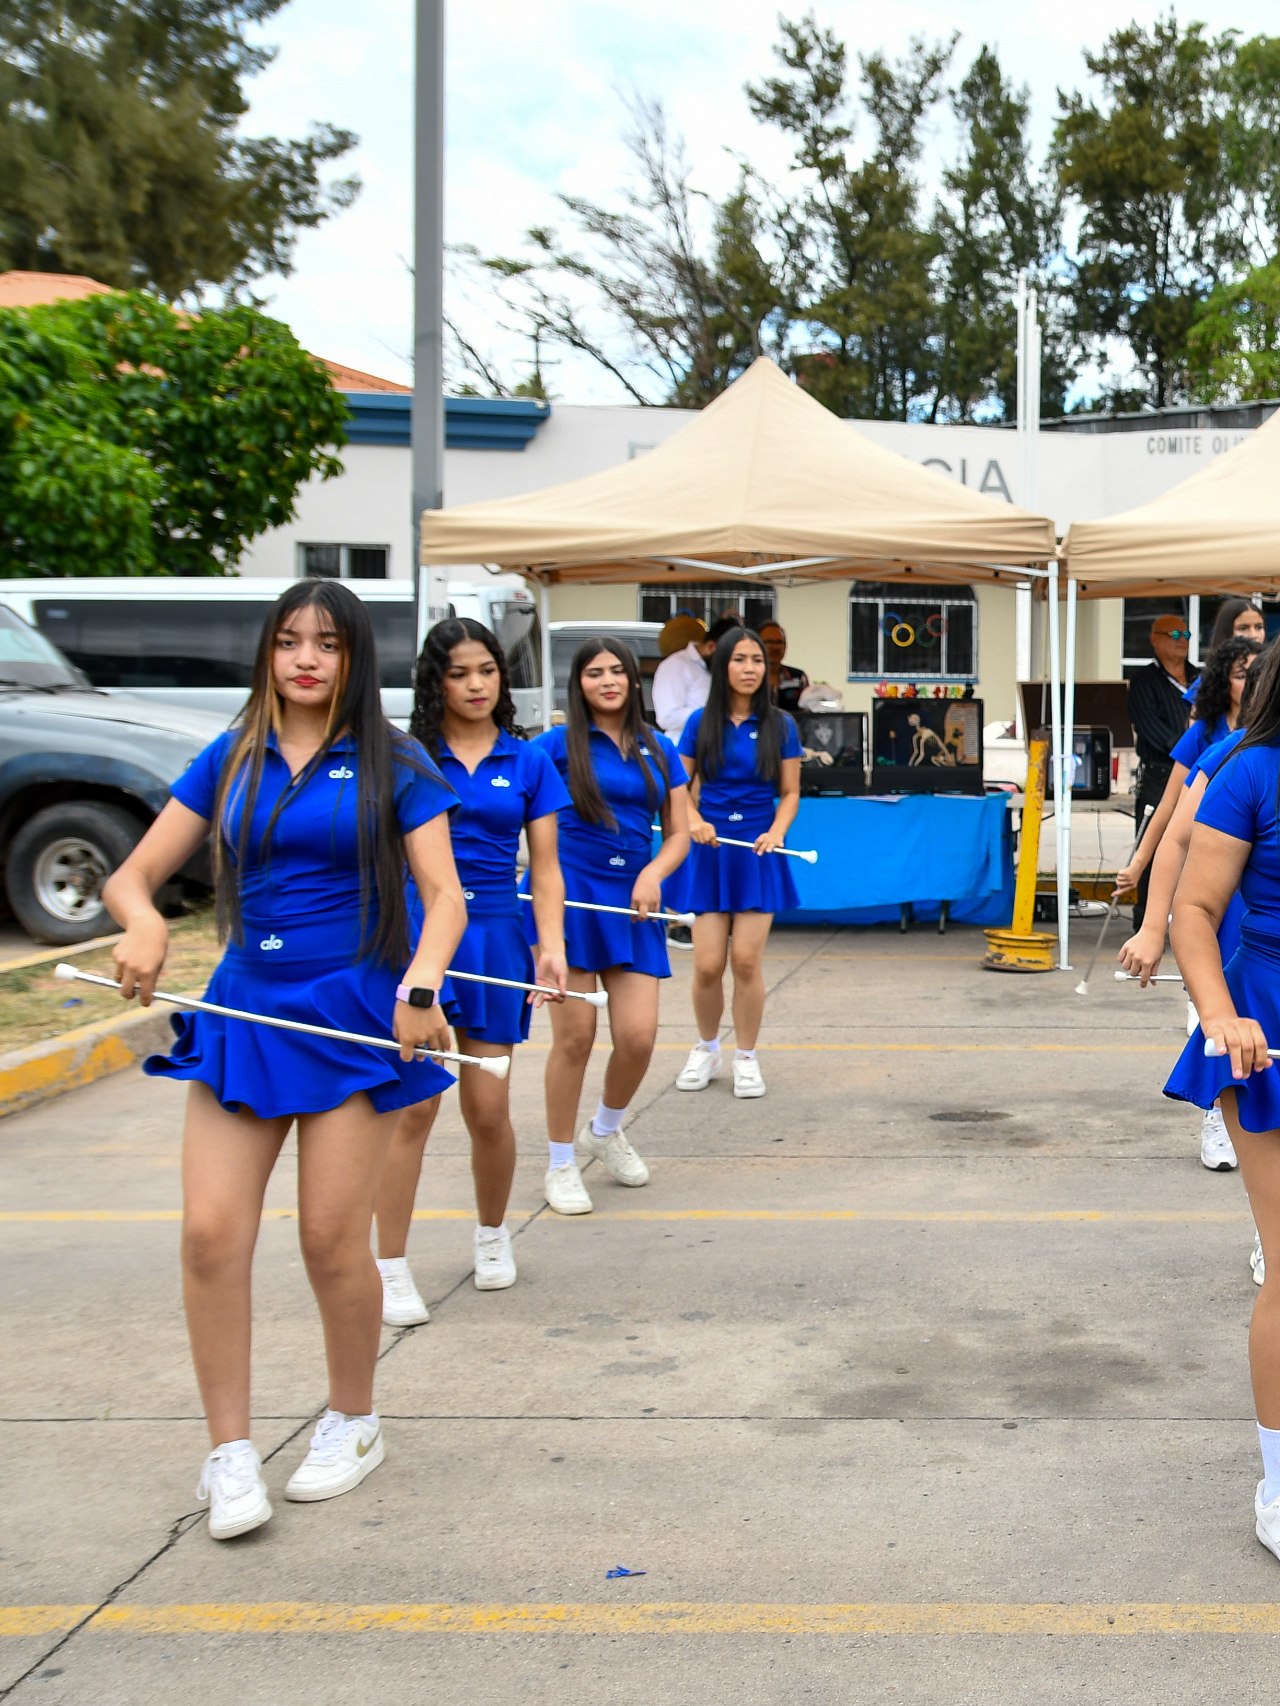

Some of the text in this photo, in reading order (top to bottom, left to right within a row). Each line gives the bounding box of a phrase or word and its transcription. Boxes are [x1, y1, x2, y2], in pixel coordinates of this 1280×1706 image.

[1147, 436, 1202, 454] COMITE
[328, 765, 354, 779] alo
[260, 933, 284, 951] alo
